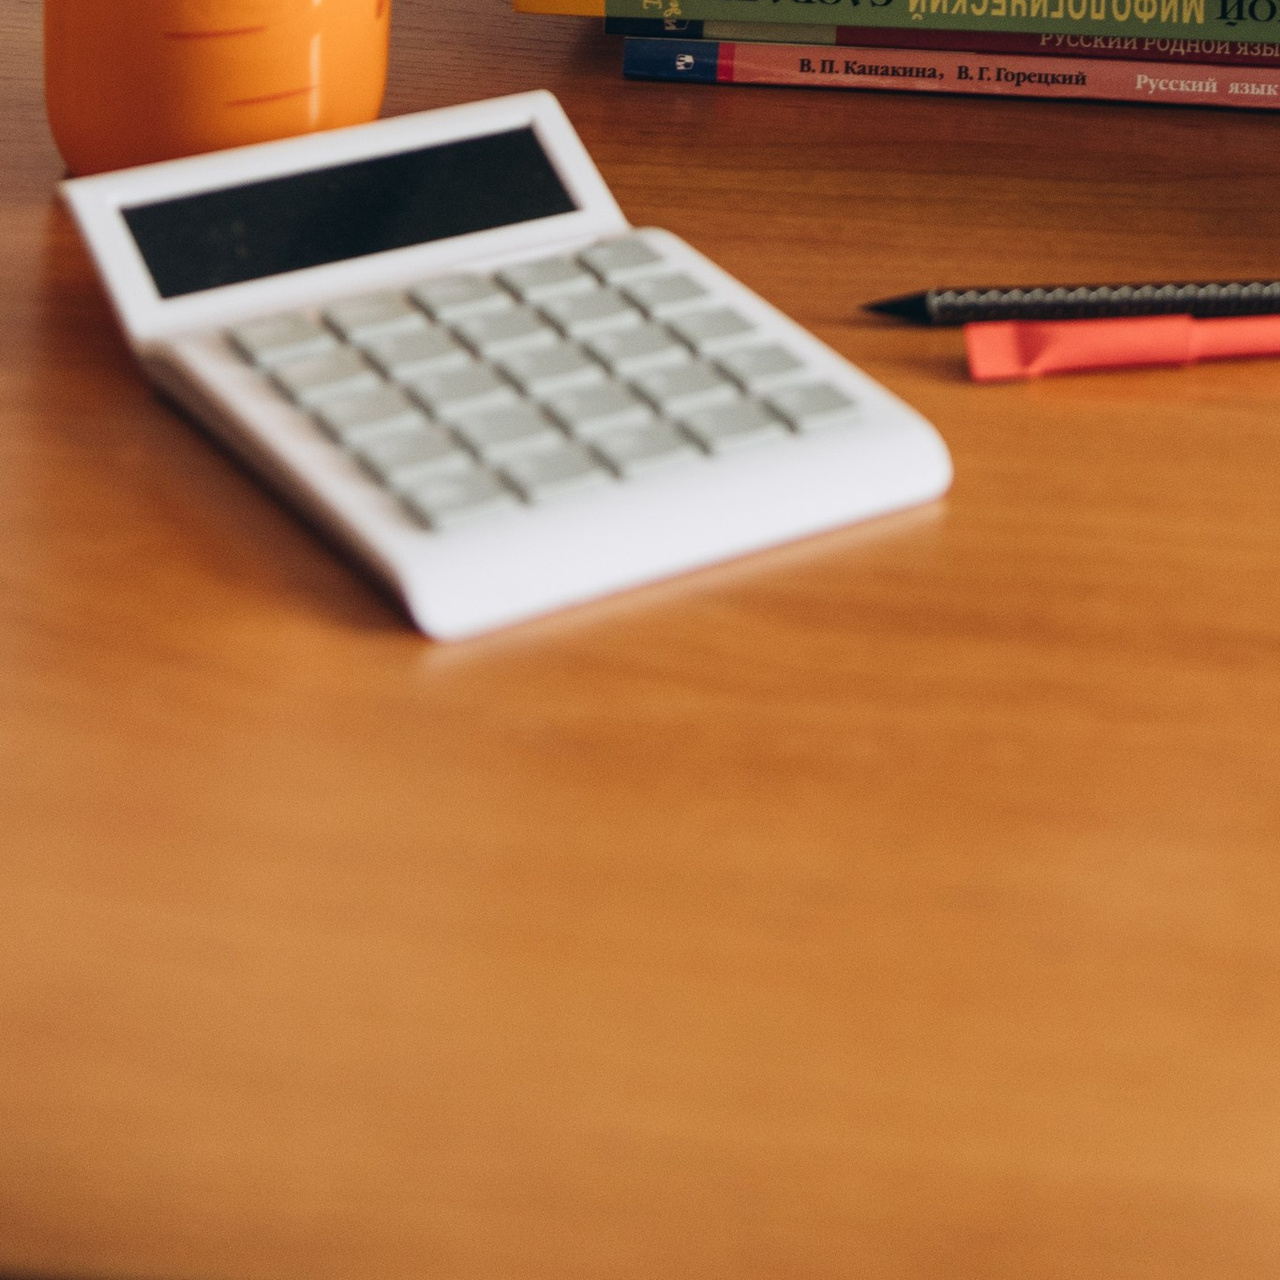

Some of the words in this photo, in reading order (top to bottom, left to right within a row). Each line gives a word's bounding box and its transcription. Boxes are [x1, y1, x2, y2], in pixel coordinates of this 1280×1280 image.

[798, 58, 816, 73] В.
[820, 59, 840, 74] П.
[843, 60, 945, 81] Канакина,
[956, 65, 974, 81] В.
[977, 66, 992, 81] Г.
[995, 67, 1087, 87] Горецкий
[1135, 73, 1218, 95] Русский
[1228, 81, 1279, 97] язык
